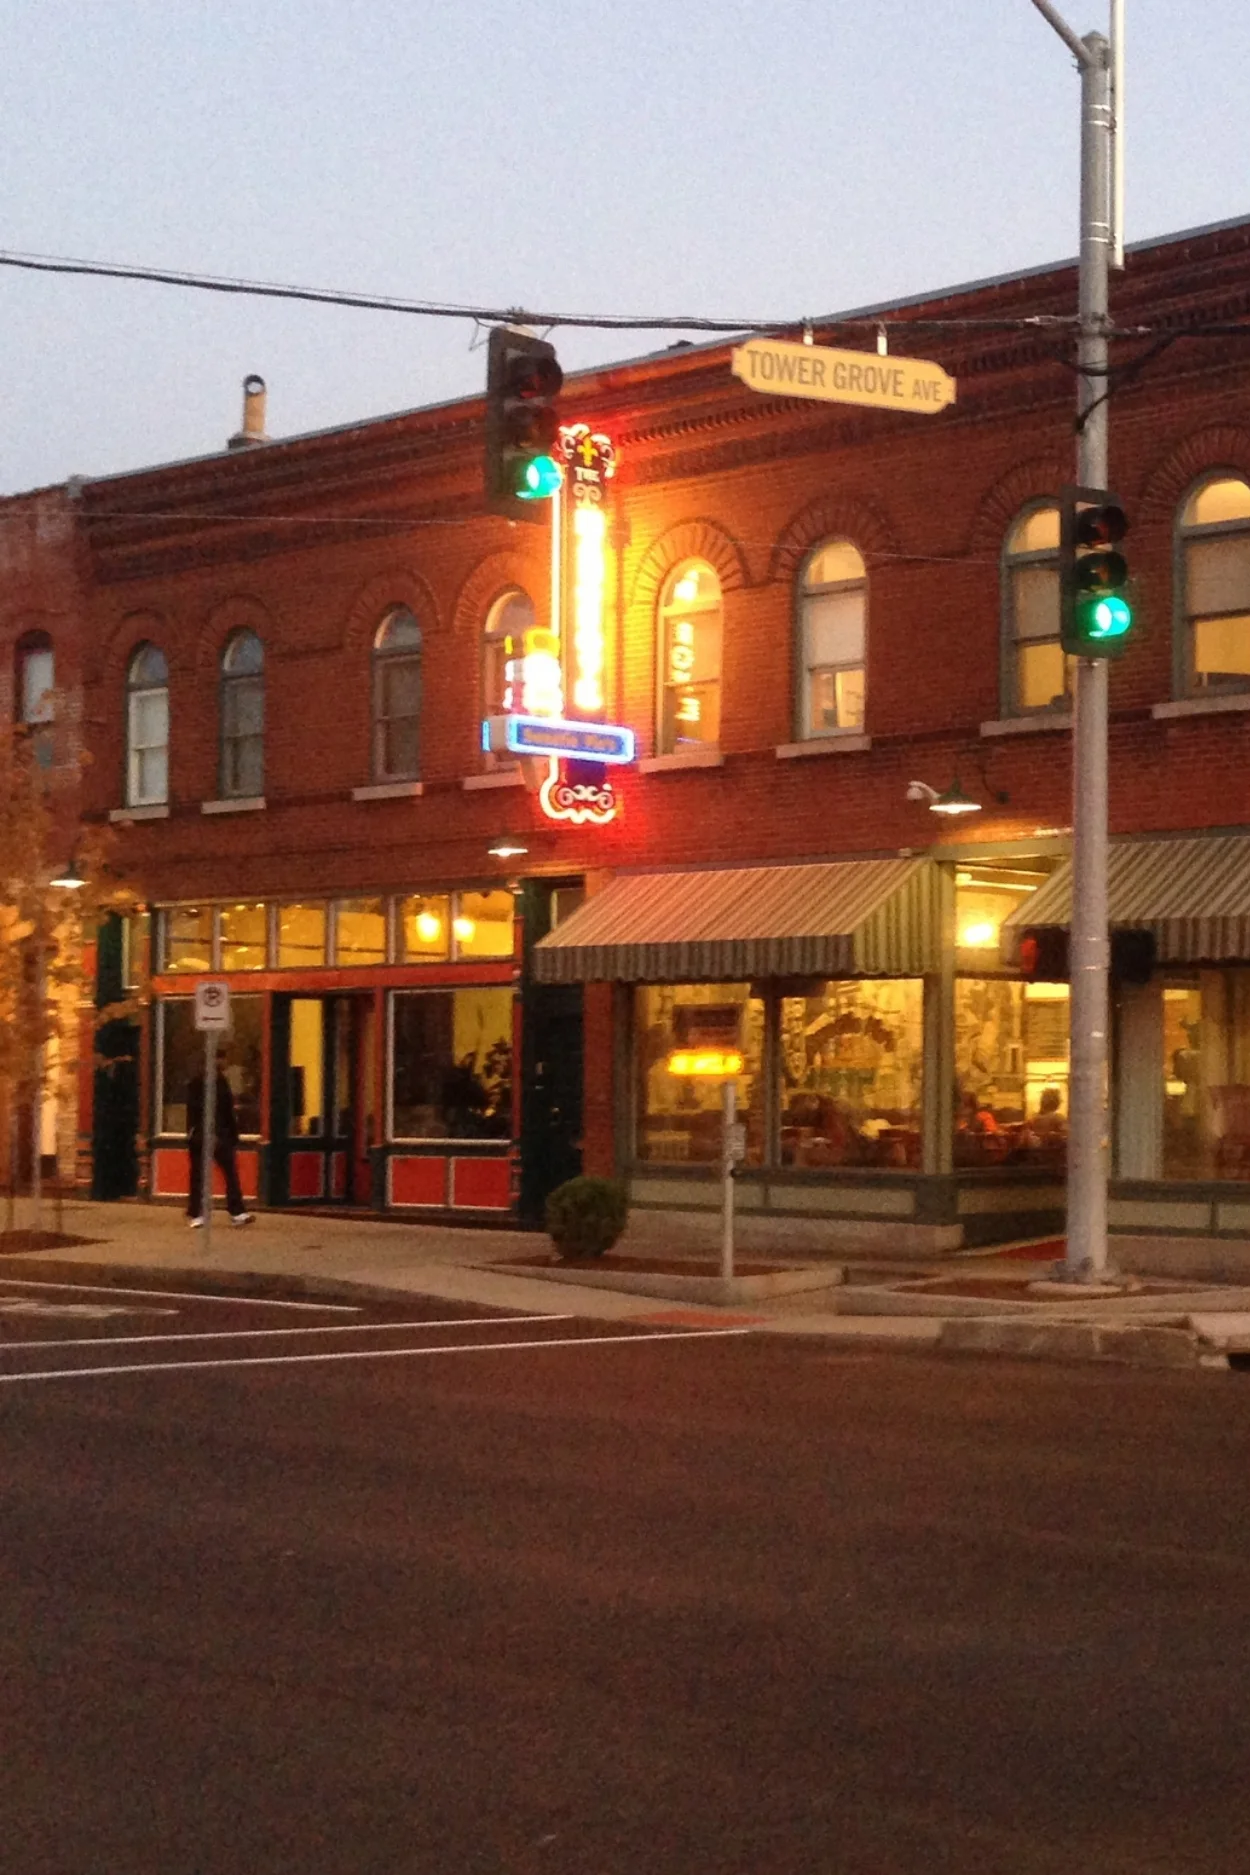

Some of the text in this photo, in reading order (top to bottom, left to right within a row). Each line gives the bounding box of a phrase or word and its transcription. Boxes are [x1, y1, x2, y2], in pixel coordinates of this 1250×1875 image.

[747, 350, 942, 402] TOWER GROVE AVE
